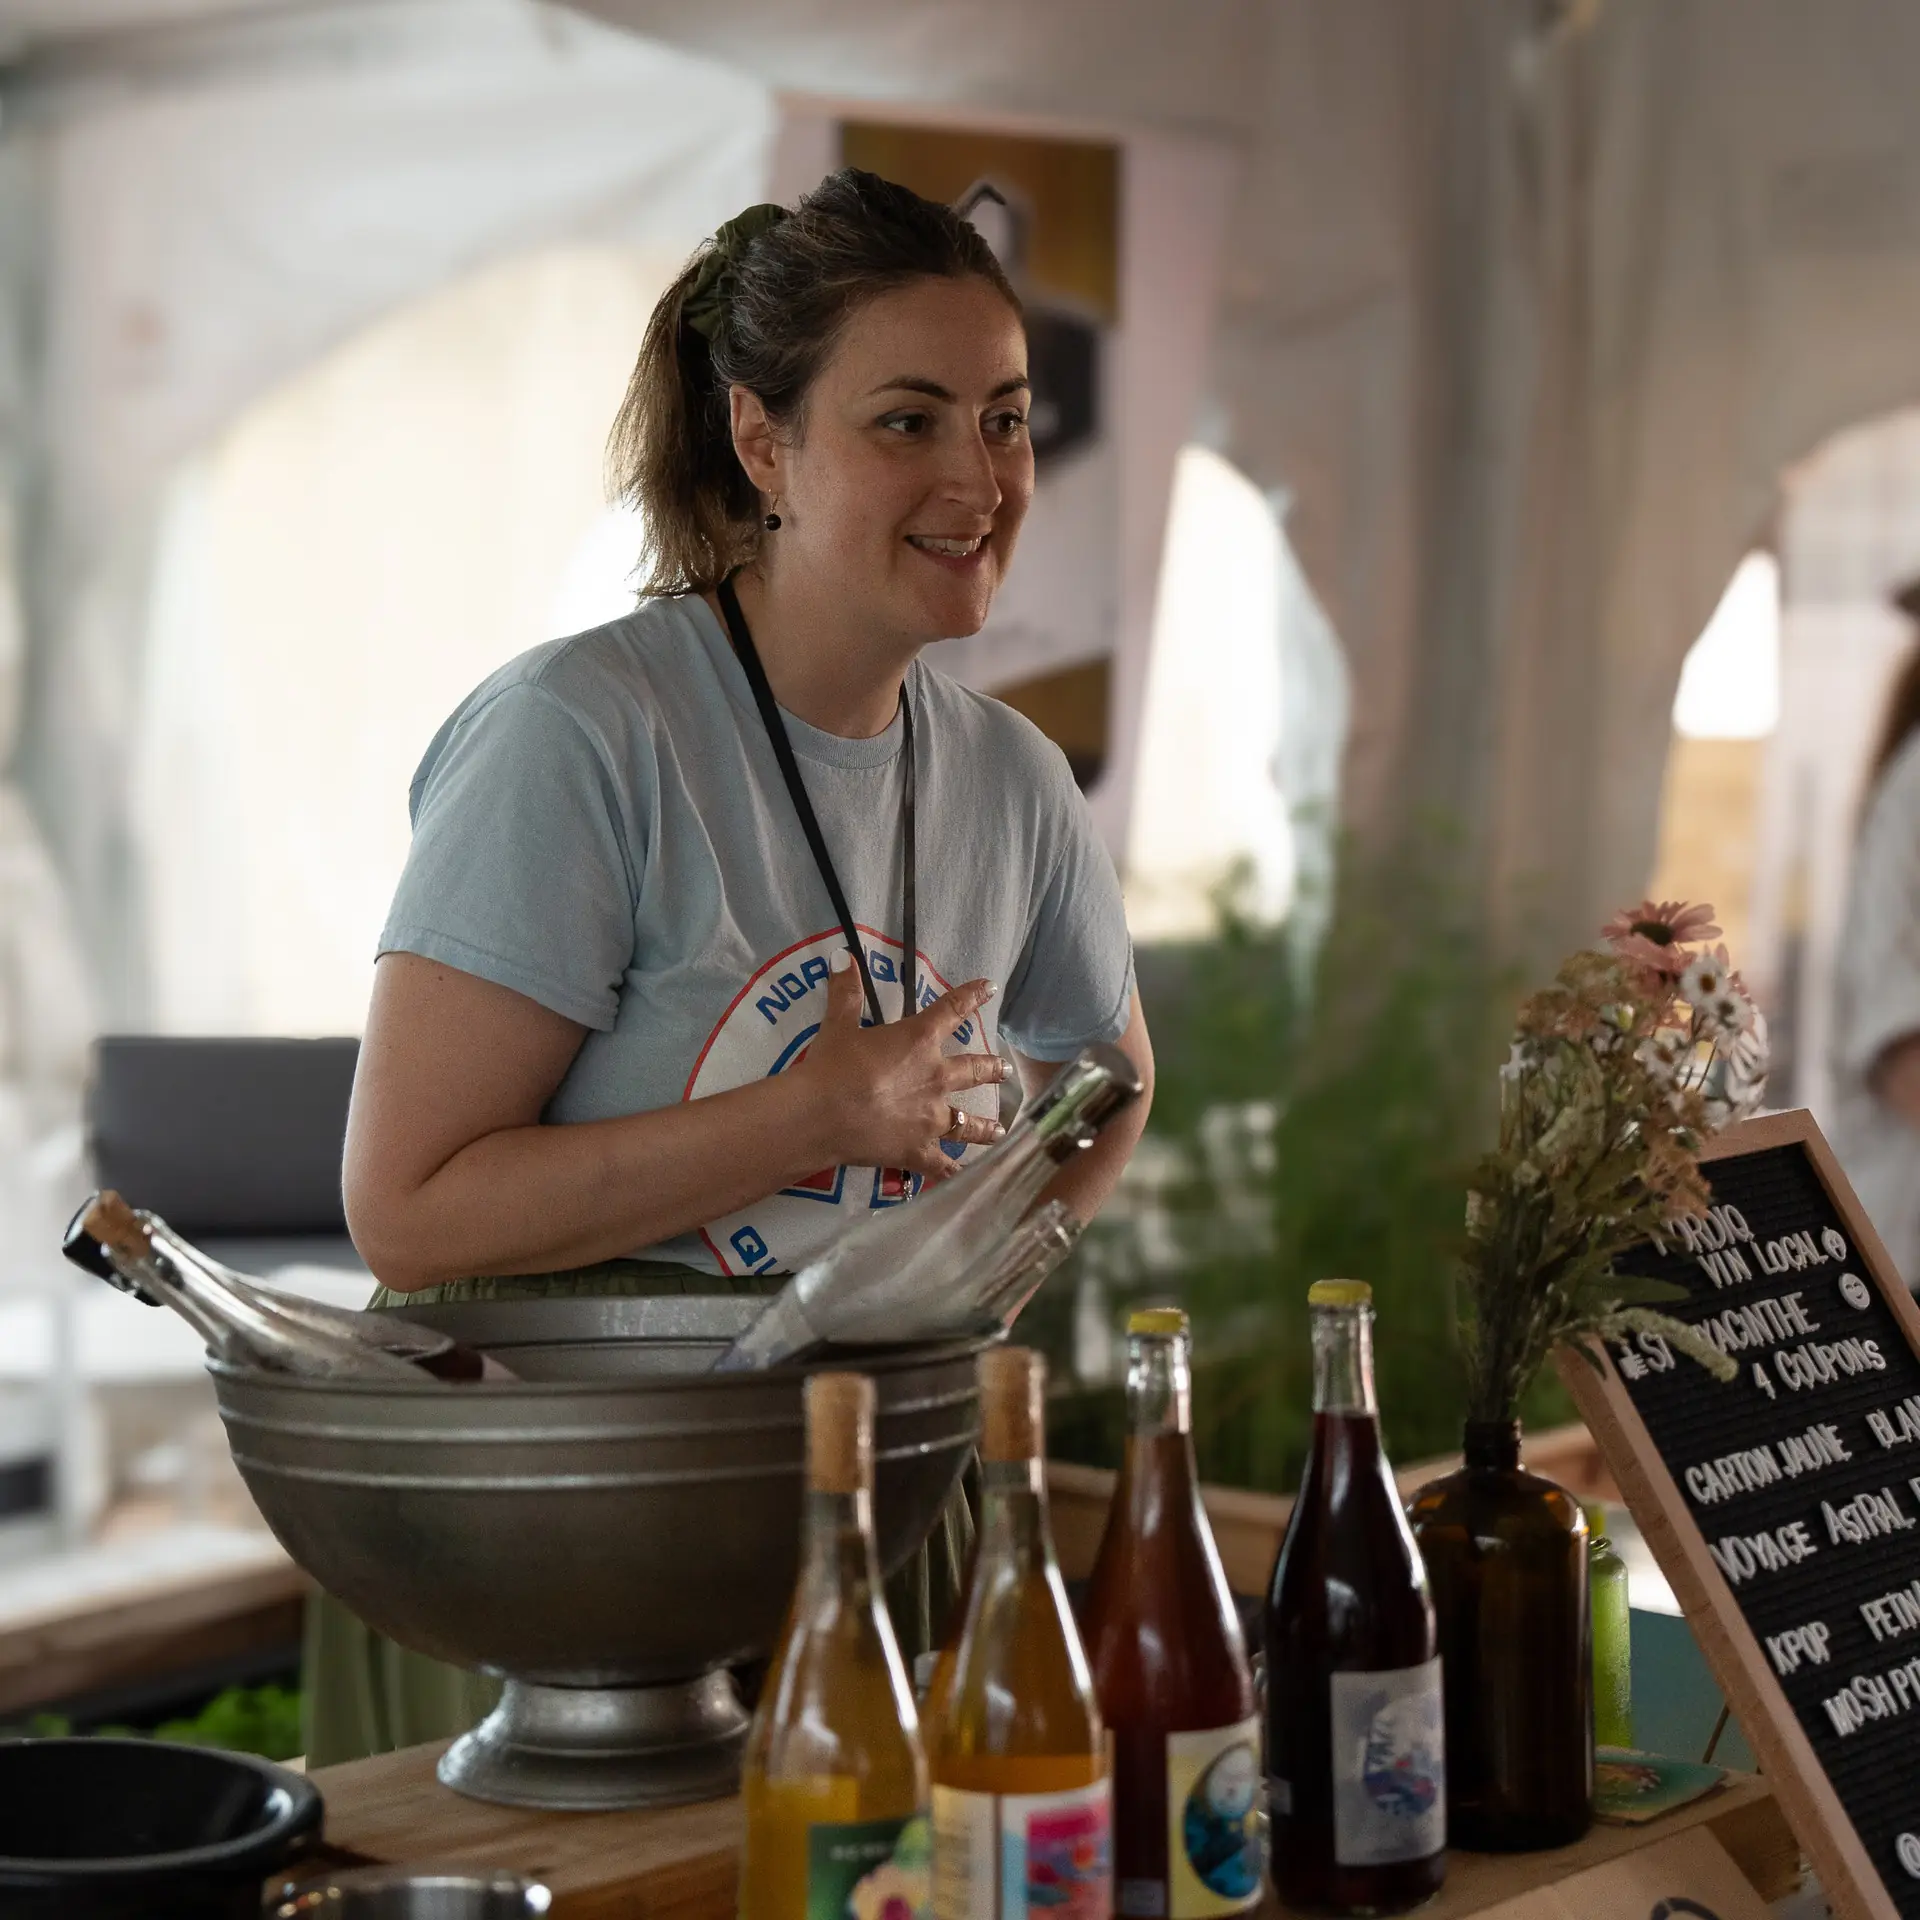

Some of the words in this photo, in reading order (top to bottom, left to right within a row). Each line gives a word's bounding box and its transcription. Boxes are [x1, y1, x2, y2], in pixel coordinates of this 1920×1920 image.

[1650, 1204, 1755, 1257] ORDIQ
[1696, 1247, 1753, 1290] VIN
[1752, 1362, 1777, 1400] 4
[1773, 1336, 1887, 1392] COUPONS
[1684, 1445, 1783, 1504] CARTON
[1777, 1422, 1853, 1478] JAUNE
[1709, 1521, 1818, 1586] VOYAGE
[1820, 1487, 1917, 1545] ASTRAL
[1765, 1621, 1831, 1676] KPOP
[1821, 1674, 1900, 1738] MOSH
